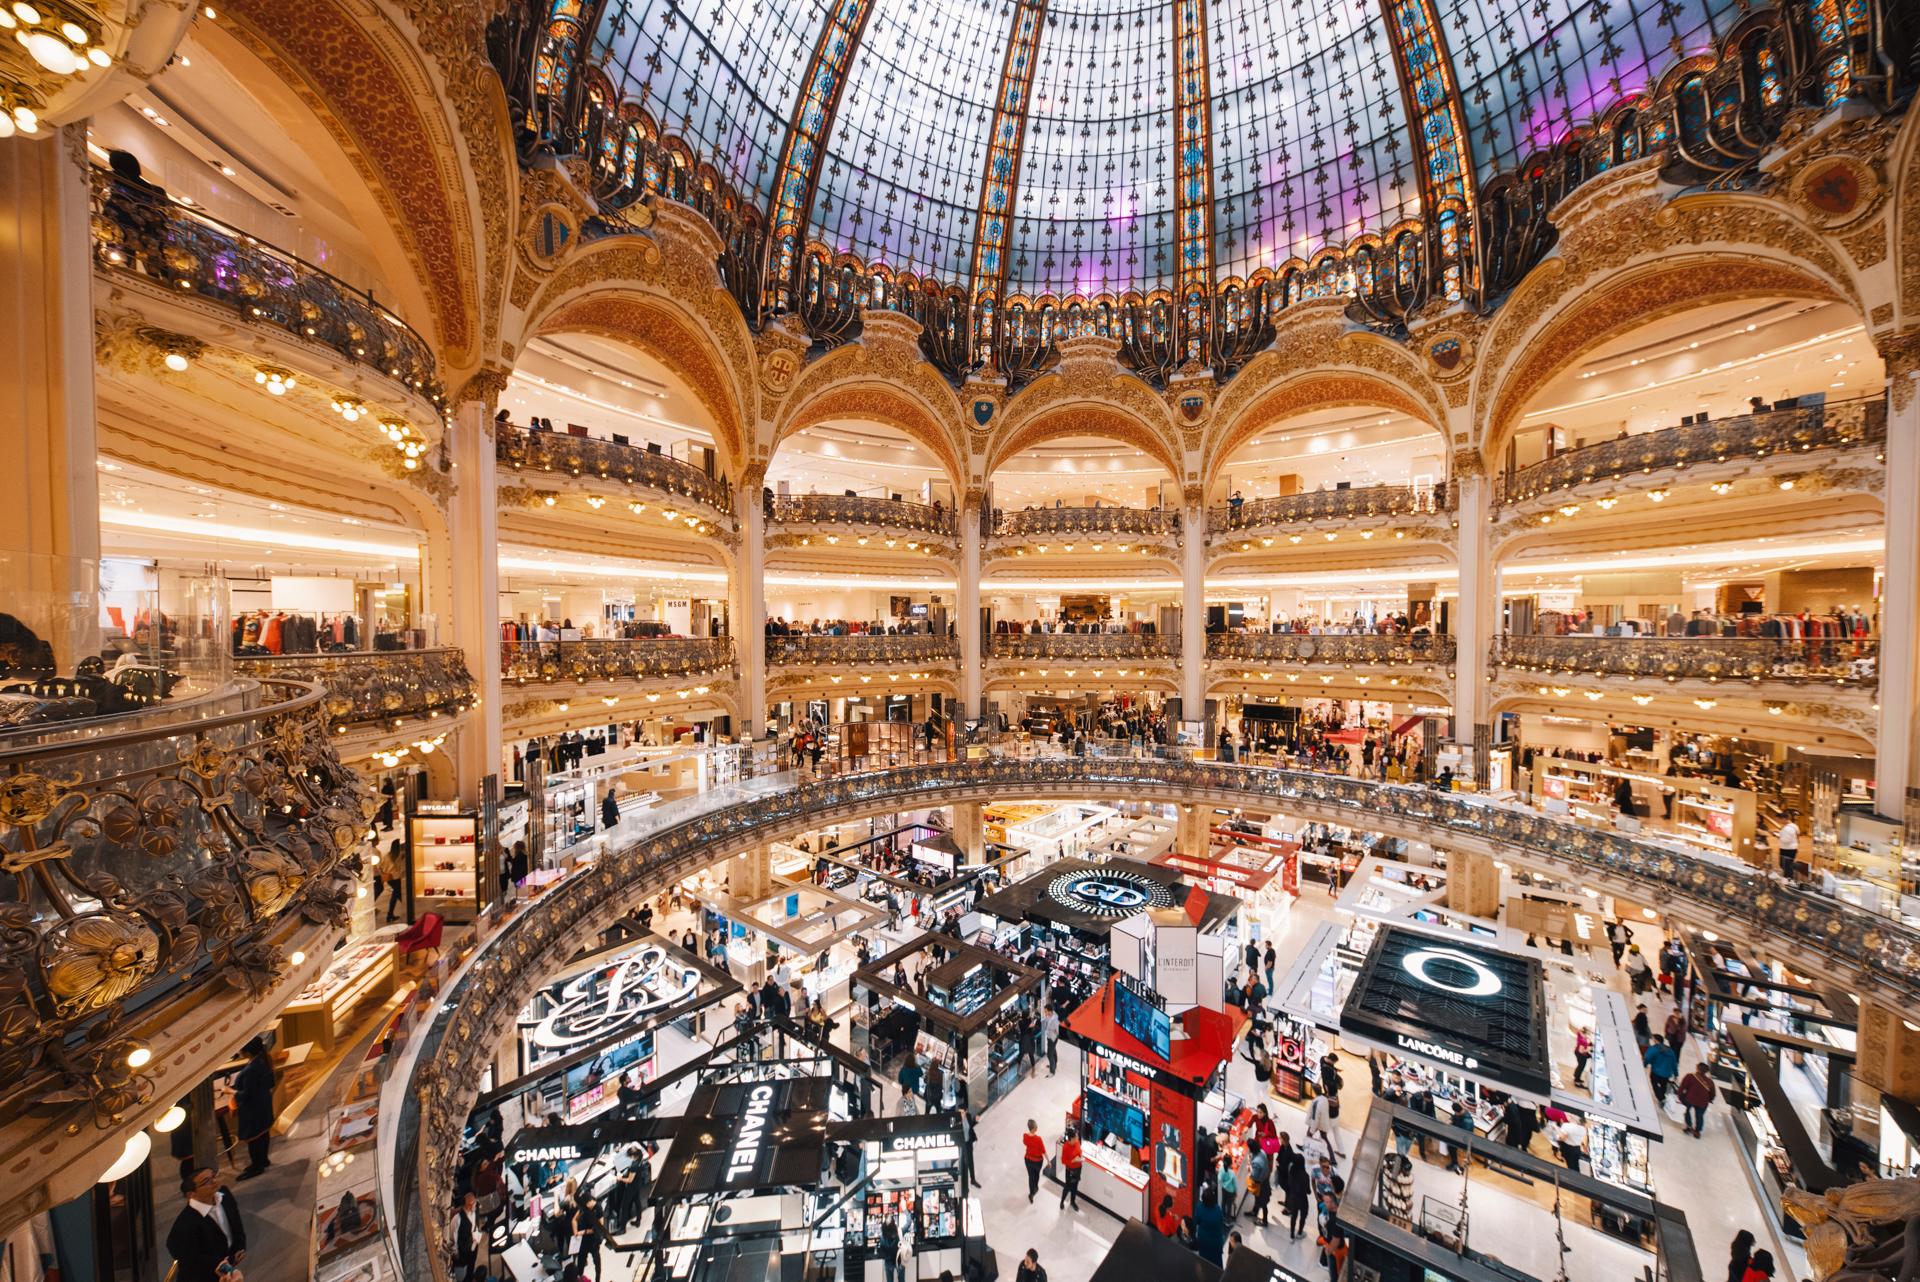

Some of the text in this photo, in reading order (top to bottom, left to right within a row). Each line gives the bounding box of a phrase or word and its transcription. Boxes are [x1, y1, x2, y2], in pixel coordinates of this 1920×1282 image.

[1050, 920, 1071, 935] DIOR
[1095, 1045, 1157, 1078] GIVENCHY
[725, 1085, 773, 1183] CHANEL
[893, 1133, 955, 1151] CHANEL
[514, 1145, 581, 1162] CHANEL
